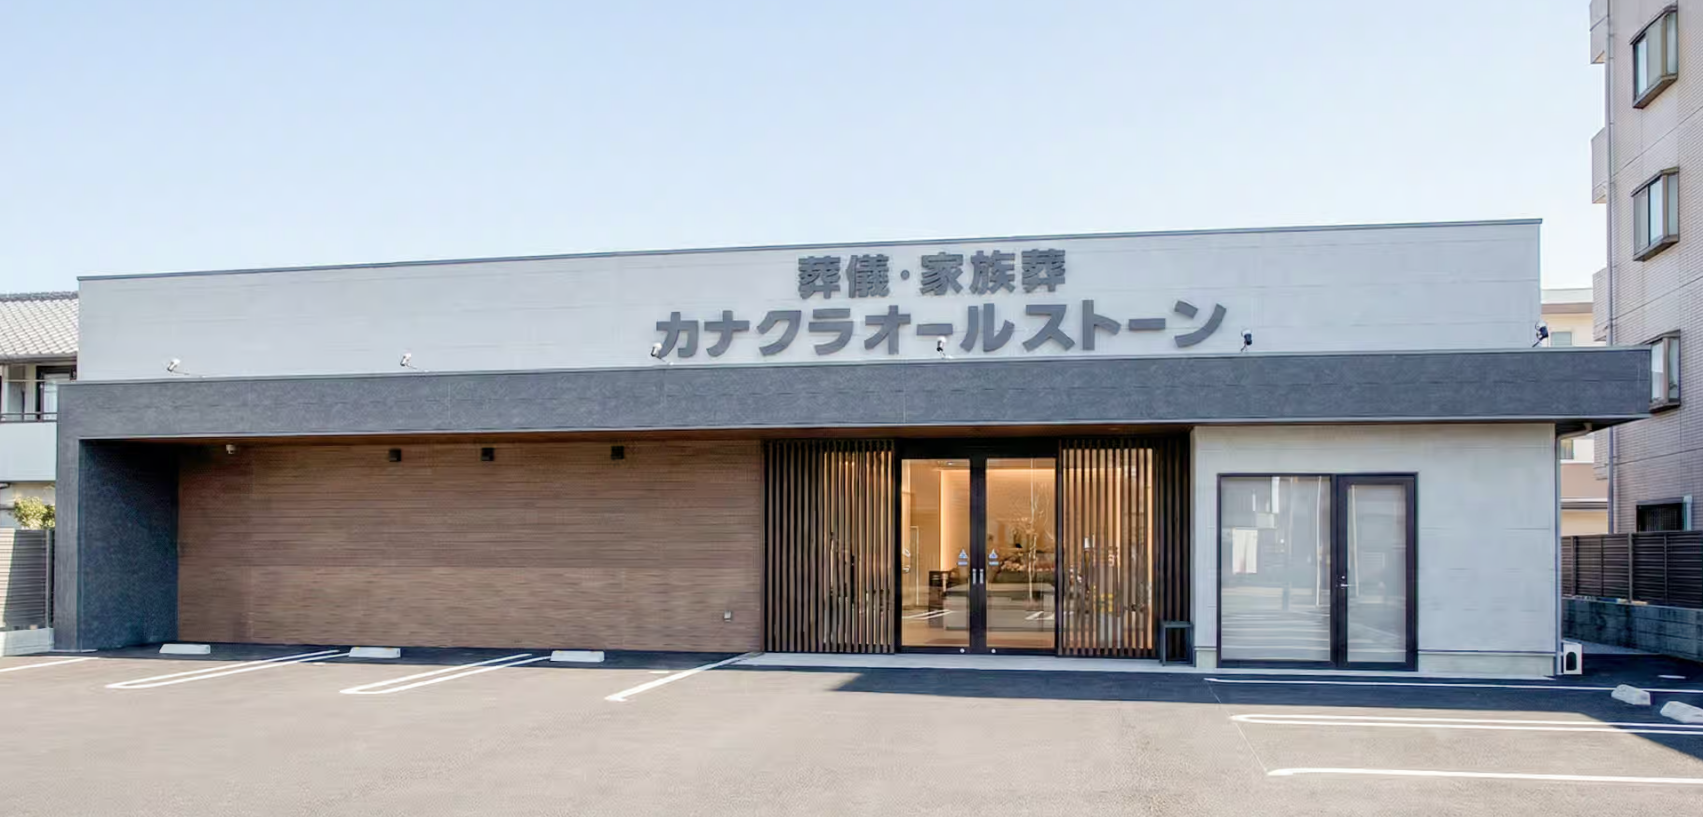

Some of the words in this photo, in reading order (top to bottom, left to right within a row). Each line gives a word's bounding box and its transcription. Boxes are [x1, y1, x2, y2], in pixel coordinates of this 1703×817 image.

[798, 248, 1066, 299] 葬儀・家族葬
[656, 299, 1227, 358] カナクラオールストーン
